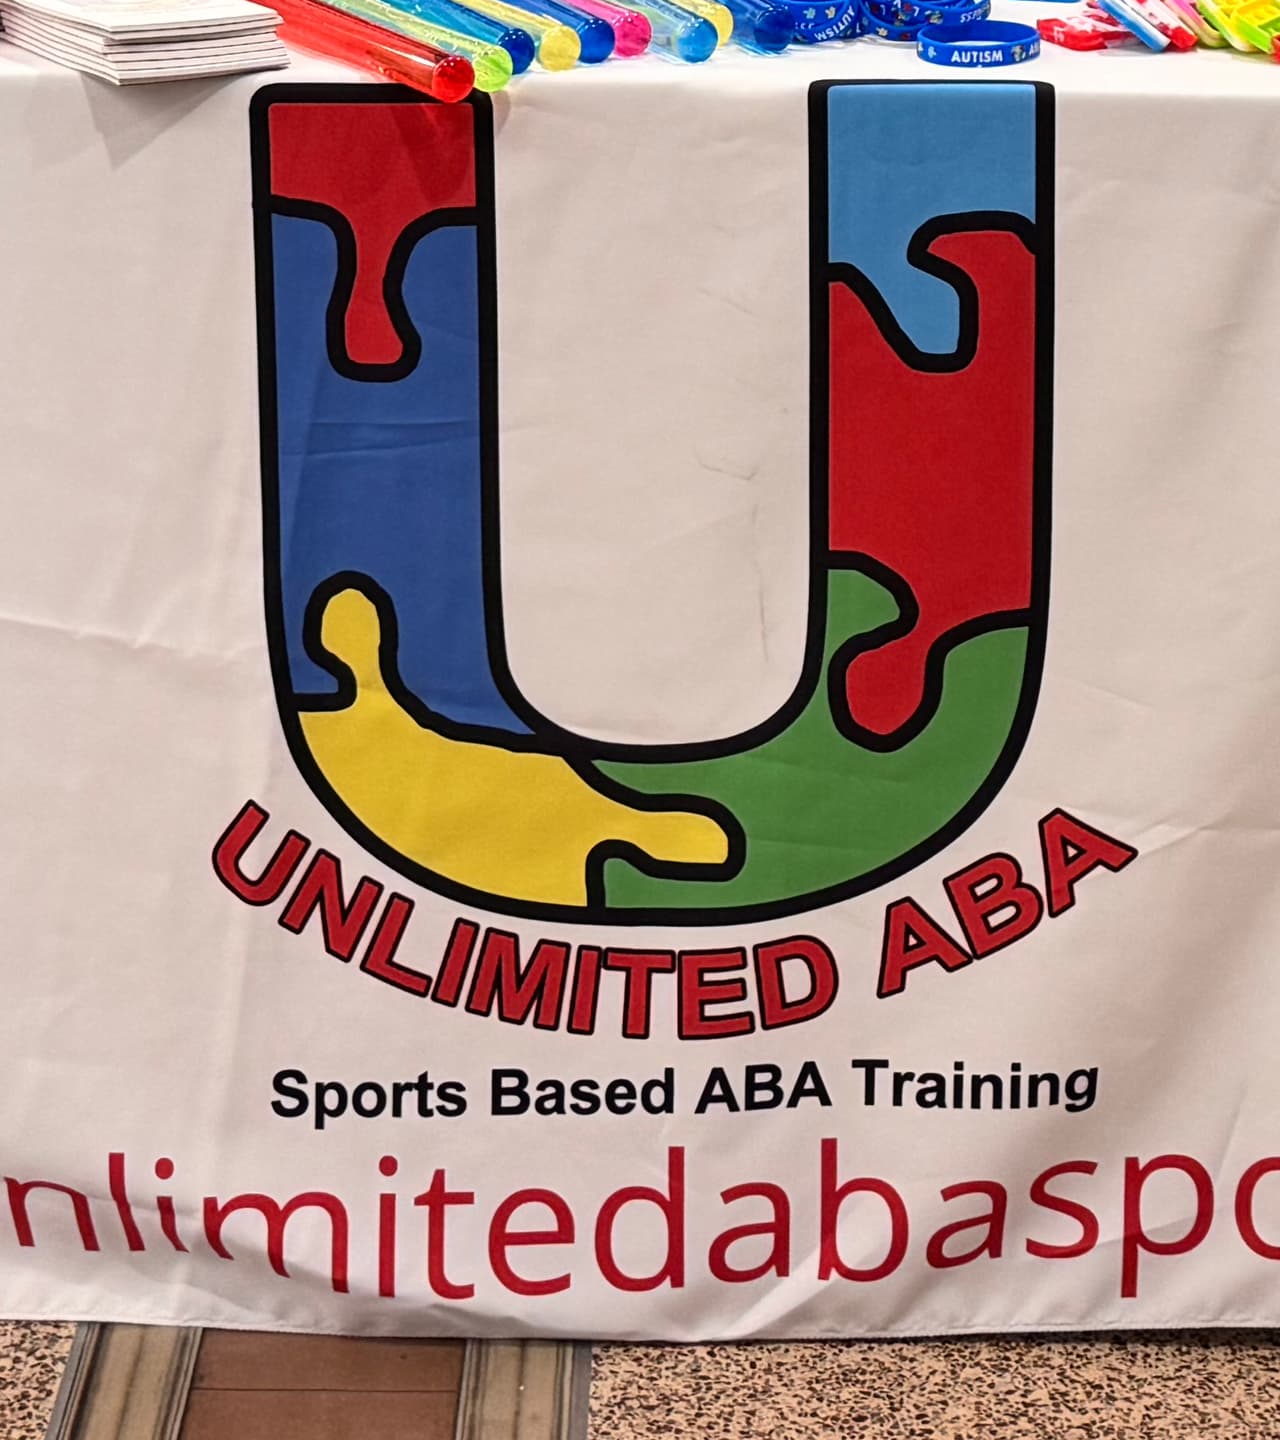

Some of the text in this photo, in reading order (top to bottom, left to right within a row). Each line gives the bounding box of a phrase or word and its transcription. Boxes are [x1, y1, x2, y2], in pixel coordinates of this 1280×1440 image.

[814, 6, 855, 41] AUTISM
[951, 50, 1003, 63] AUTISM
[210, 798, 1139, 1041] UNLIMITED ABA
[269, 1058, 1100, 1130] Sports Based ABA Training
